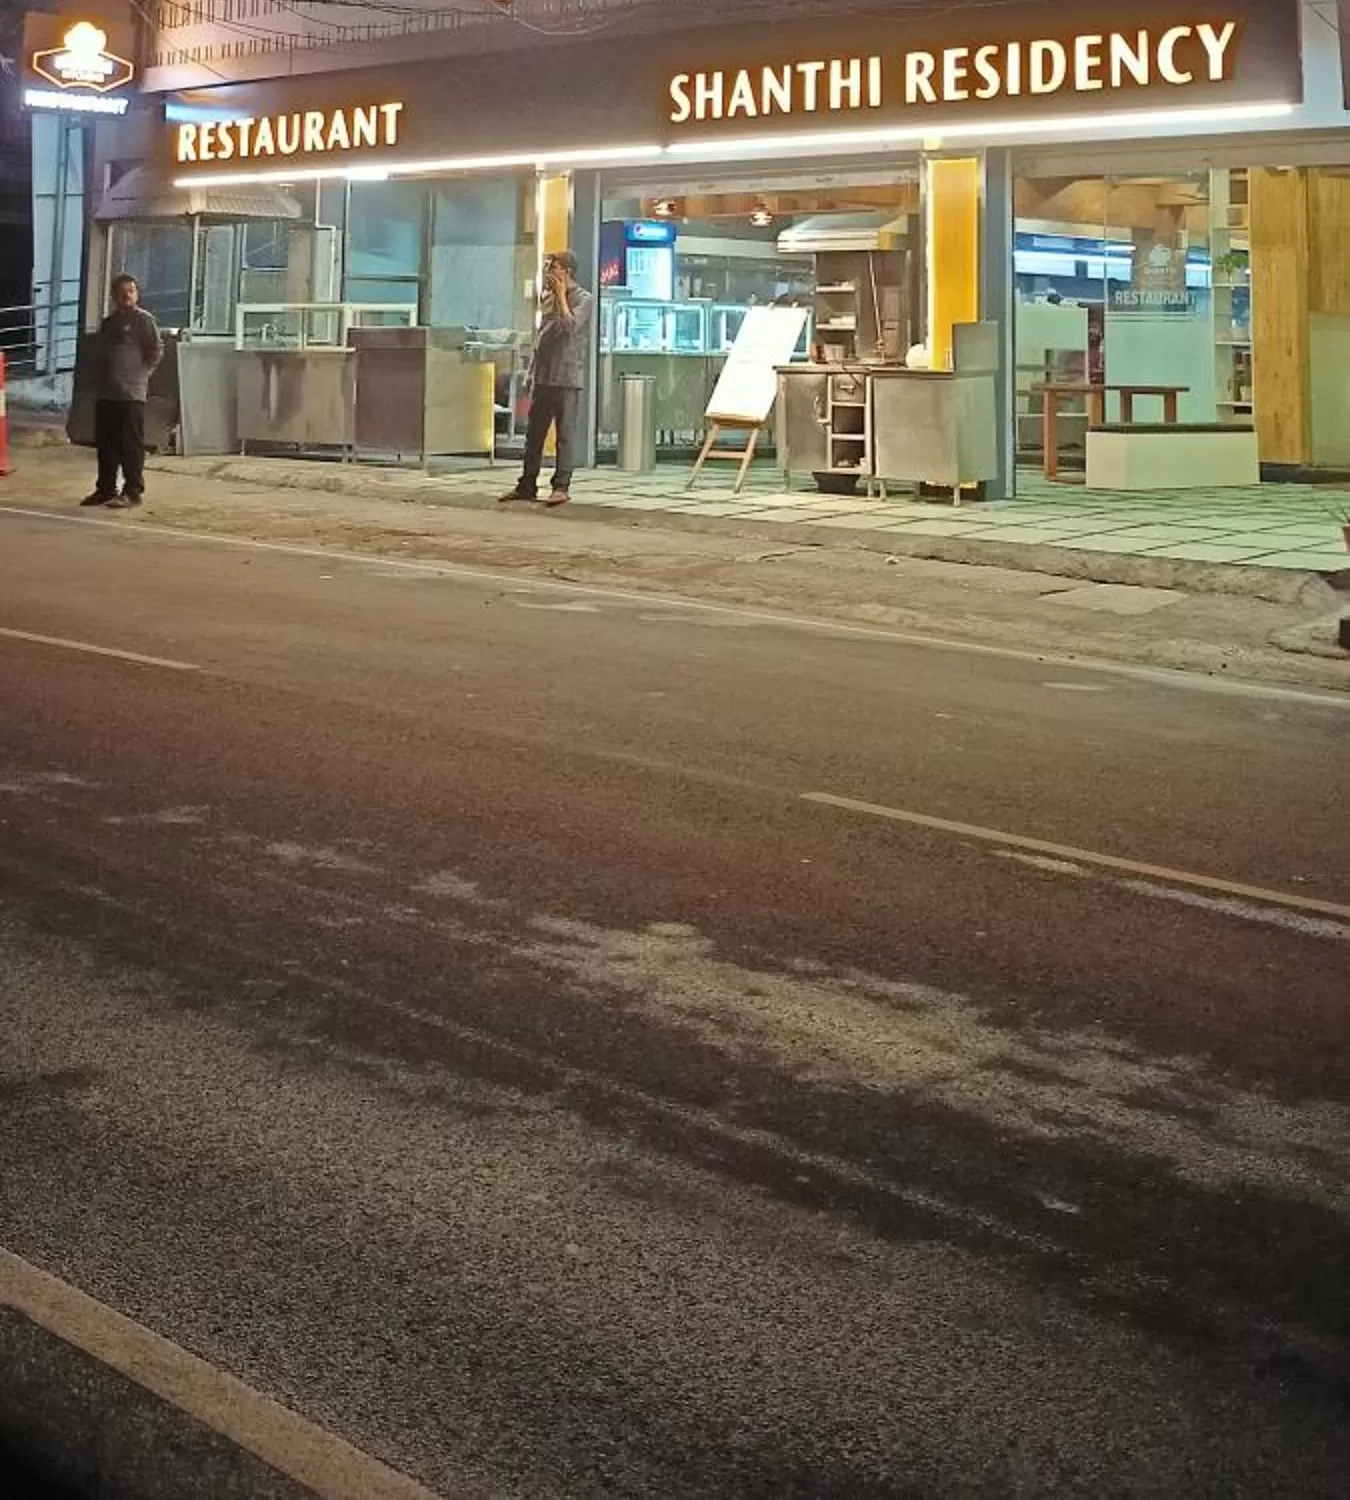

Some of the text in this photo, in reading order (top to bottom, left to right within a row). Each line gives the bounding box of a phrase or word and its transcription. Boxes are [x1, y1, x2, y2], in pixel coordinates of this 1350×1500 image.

[669, 22, 1236, 123] SHANTHI RESIDENCY
[177, 102, 403, 162] RESTAURANT
[1115, 290, 1197, 306] RESTAURANT
